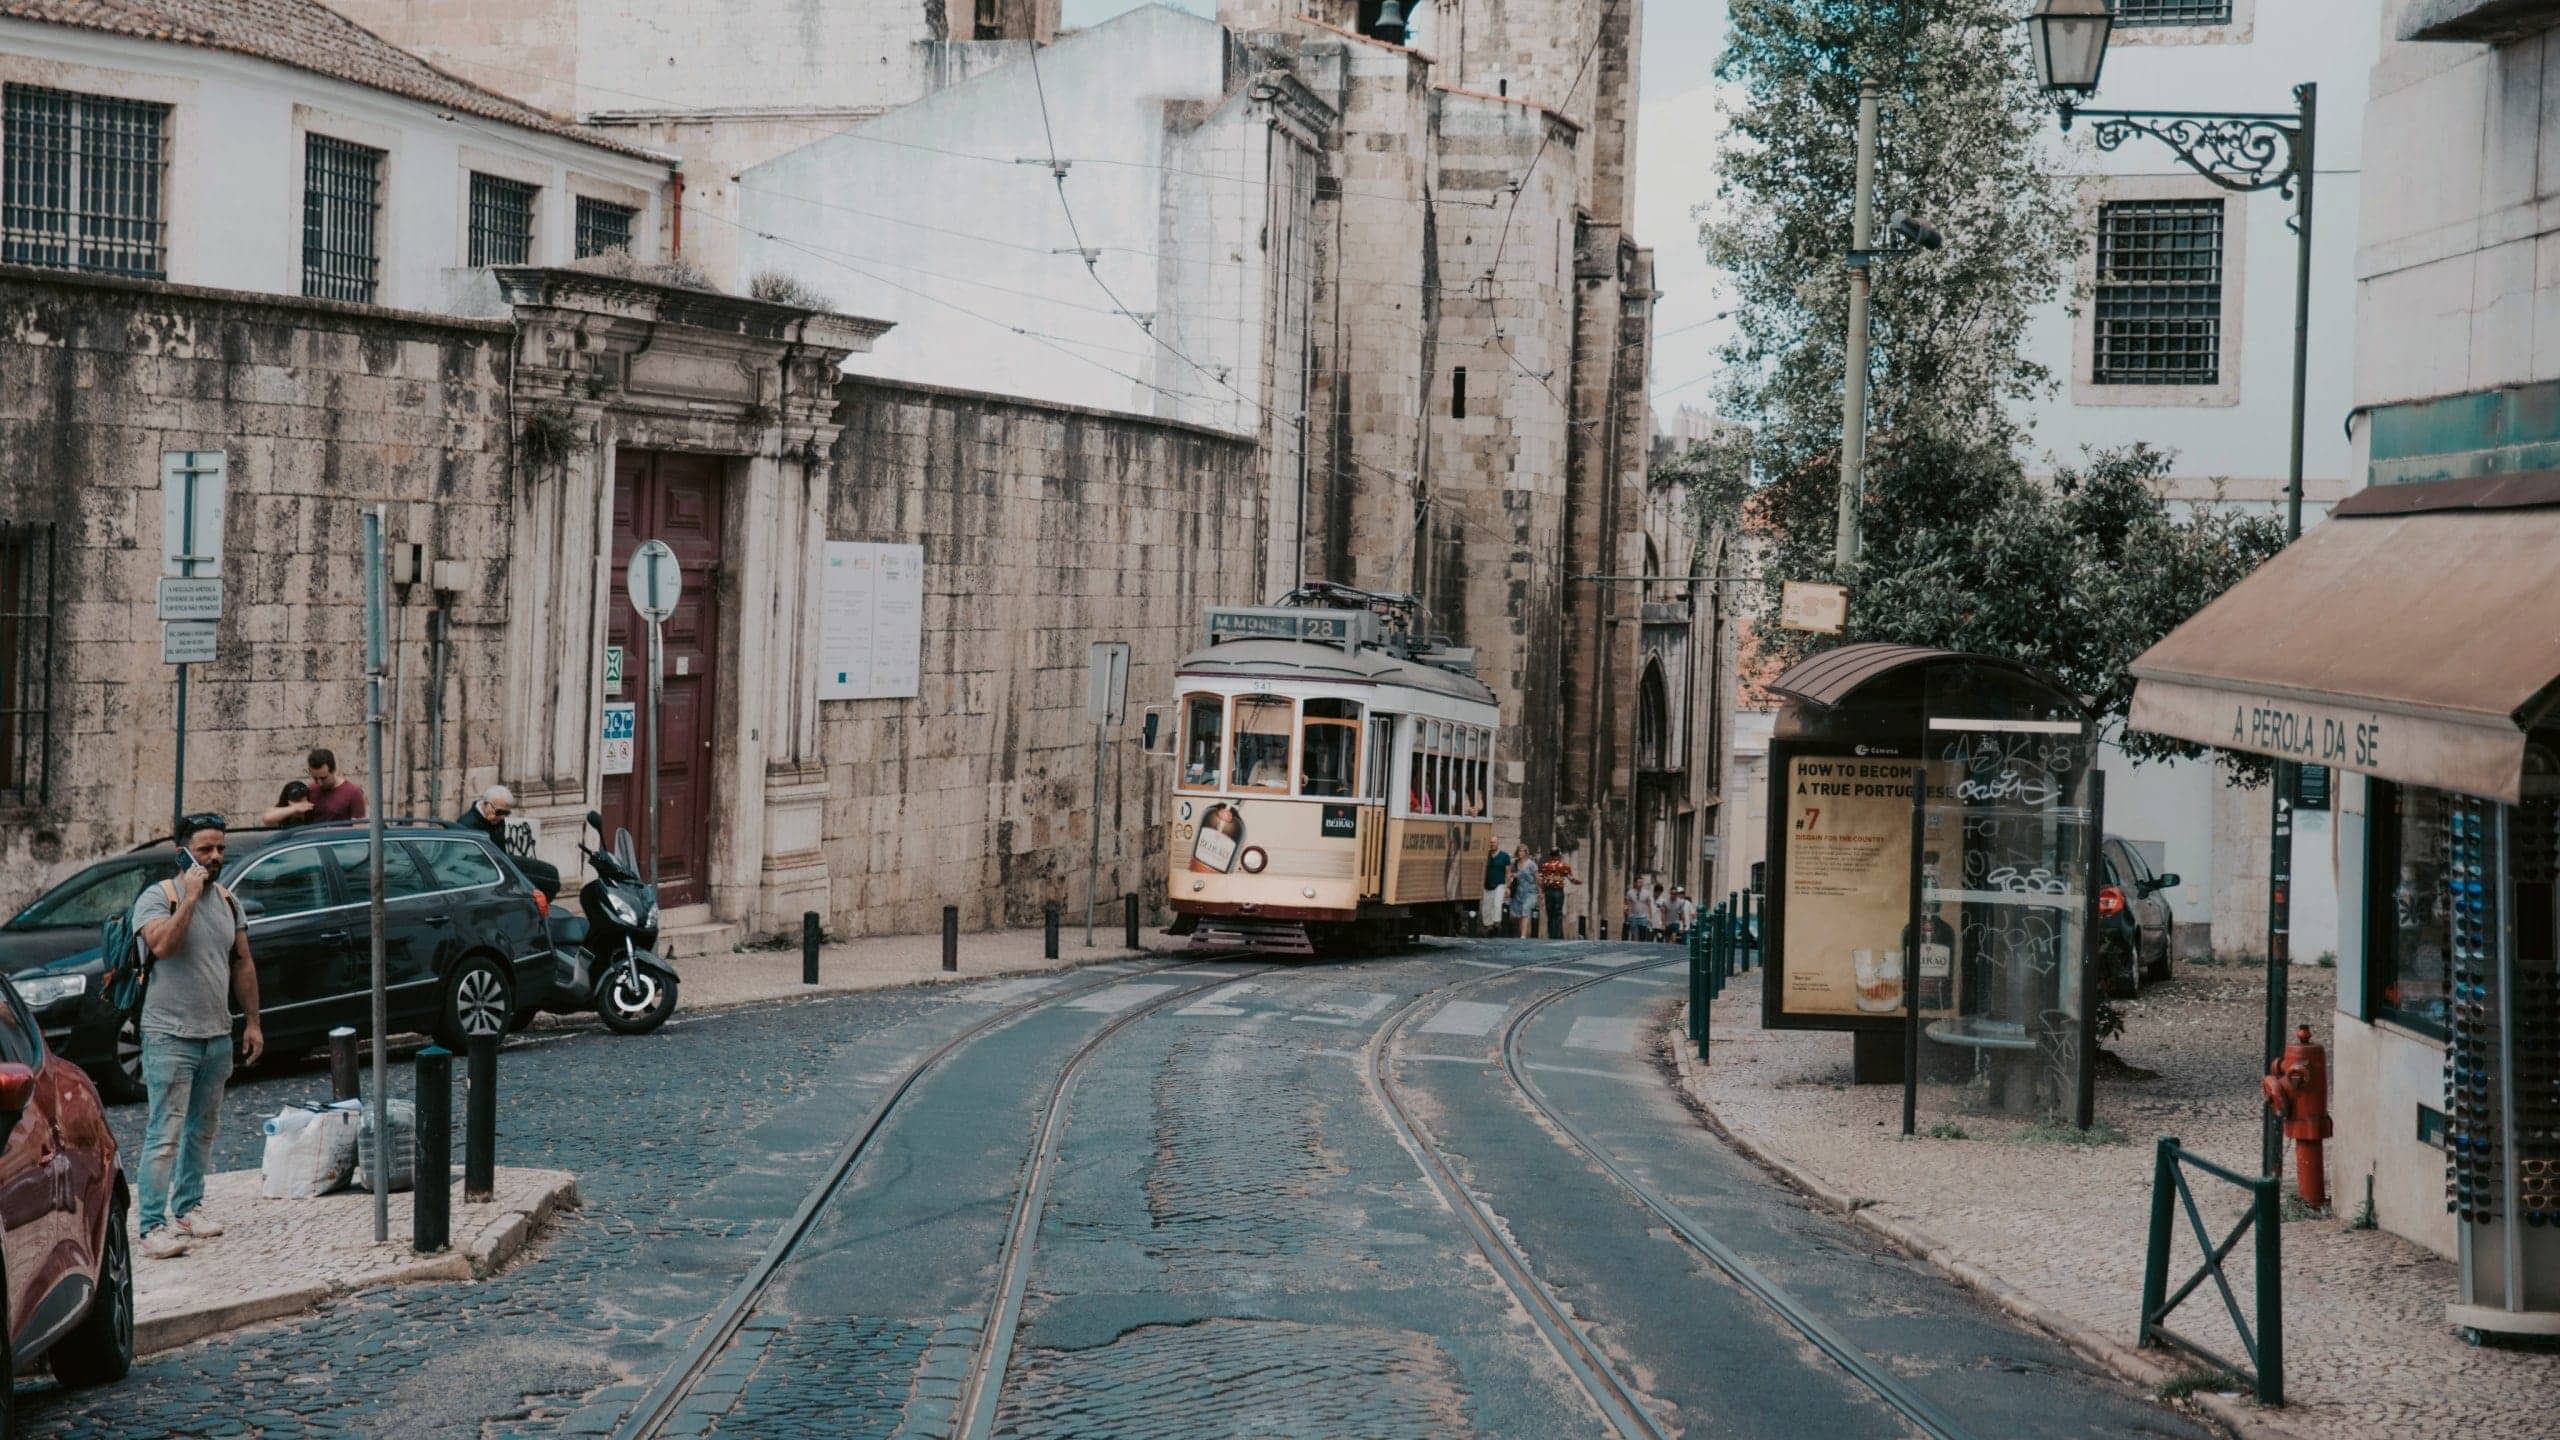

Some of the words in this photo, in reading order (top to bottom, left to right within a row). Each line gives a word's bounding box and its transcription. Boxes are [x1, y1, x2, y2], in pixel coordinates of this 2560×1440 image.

[1307, 620, 1334, 637] 28
[2232, 705, 2243, 742] A
[2251, 700, 2314, 756] PÉROLA
[2322, 718, 2346, 762] DA
[2356, 714, 2379, 767] SÉ
[1797, 763, 1833, 777] HOW
[1837, 765, 1855, 778] TO
[1859, 765, 1912, 779] BECOM
[1796, 782, 1807, 796] A
[1811, 783, 1850, 797] TRUE
[1854, 783, 1955, 799] PORTUGESE
[1795, 808, 1820, 831] #7
